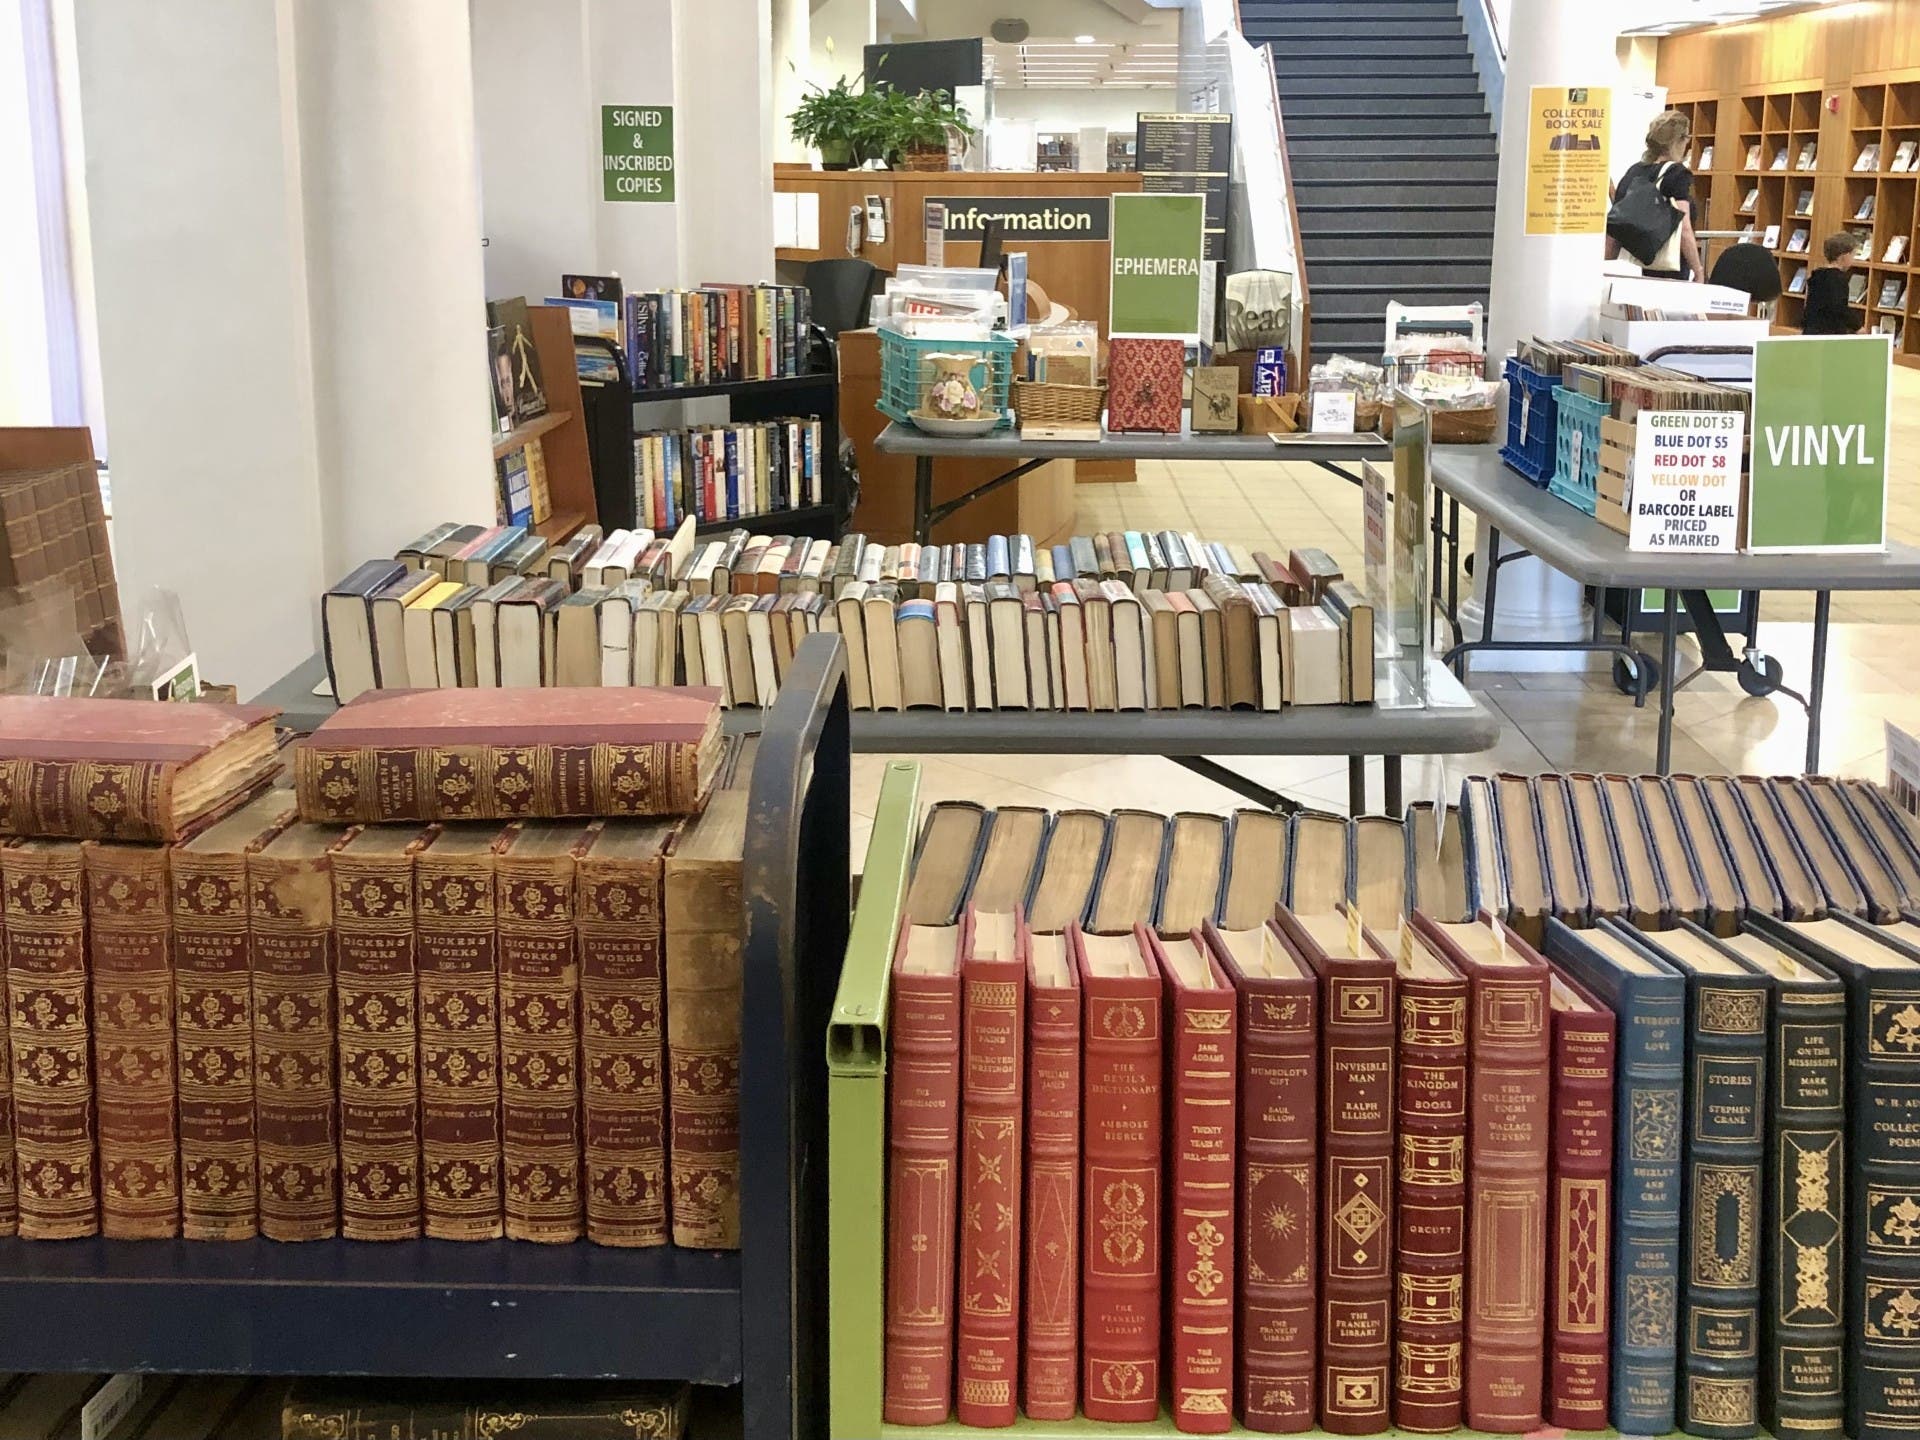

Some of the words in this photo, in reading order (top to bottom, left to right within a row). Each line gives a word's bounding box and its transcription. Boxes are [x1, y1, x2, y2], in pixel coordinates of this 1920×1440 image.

[1542, 108, 1604, 118] COLLECTIBLE
[613, 110, 662, 127] SIGNED
[1546, 119, 1577, 129] BOOK
[1582, 119, 1602, 129] SALE
[633, 133, 643, 149] &
[604, 155, 673, 171] INSCRIBED
[616, 177, 662, 193] COPIES
[944, 208, 1091, 230] Infomation
[1115, 257, 1199, 276] EPHEMERA
[638, 303, 649, 334] Silva
[1650, 415, 1690, 428] GREEN
[1693, 416, 1718, 429] DOT
[1654, 435, 1684, 448] BLUE
[1687, 436, 1712, 448] DOT
[1764, 424, 1875, 466] VINYL
[1654, 454, 1678, 467] RED
[1681, 455, 1706, 468] DOT
[1651, 474, 1699, 486] YELLOW
[1702, 475, 1726, 487] DOT
[1679, 490, 1696, 502] OR
[1638, 503, 1696, 517] BARCODE
[1699, 504, 1734, 518] LABEL
[1664, 519, 1707, 532] PRICED
[1649, 534, 1664, 546] AS
[1668, 534, 1720, 547] MARKED
[380, 756, 391, 815] DICKENS
[12, 934, 74, 945] DICKENS
[180, 936, 242, 946] DICKENS
[257, 938, 320, 948] DICKENS
[343, 938, 406, 947] DICKENS
[424, 936, 486, 946] DICKENS
[504, 940, 566, 950] DICKENS
[588, 942, 652, 951] DICKENS
[19, 946, 66, 958] WORKS
[186, 947, 233, 956] WORKS
[263, 950, 311, 959] WORKS
[350, 950, 397, 958] WORKS
[431, 948, 478, 956] WORKS
[510, 951, 558, 960] WORKS
[596, 954, 644, 962] WORKS
[975, 1026, 1010, 1034] THOMAS
[1804, 1036, 1824, 1045] LIFE
[1198, 1044, 1218, 1052] JANE
[1797, 1047, 1812, 1056] ON
[1814, 1047, 1830, 1056] THE
[1192, 1052, 1225, 1062] ADDAMS
[1336, 1062, 1388, 1072] INVISIBLE
[1788, 1058, 1838, 1067] MISSISSIPPI
[1112, 1064, 1136, 1072] THE
[1250, 1066, 1308, 1076] HUMBOLDT'S
[1103, 1074, 1146, 1084] DEVIL'S
[1348, 1072, 1376, 1083] MAN
[1424, 1071, 1446, 1080] THE
[1708, 1075, 1752, 1085] STORIES
[1270, 1078, 1290, 1086] GIFT
[1407, 1080, 1458, 1090] KINGDOM
[1800, 1076, 1828, 1086] MARK
[1092, 1084, 1157, 1094] DICTIONARY
[1502, 1085, 1522, 1093] THE
[1798, 1088, 1829, 1098] TWAIN
[1482, 1094, 1538, 1103] COLLECTED
[1346, 1102, 1378, 1112] RALPH
[1415, 1100, 1452, 1110] BOOKS
[1494, 1104, 1527, 1113] POEMS
[1708, 1105, 1750, 1114] STEPHEN
[1268, 1106, 1290, 1115] SAUL
[1342, 1110, 1381, 1120] ELLISON
[1263, 1114, 1296, 1123] BELLOW
[1714, 1114, 1747, 1124] CRANE
[1100, 1120, 1149, 1129] AMBROSE
[1488, 1123, 1532, 1132] WALLACE
[1192, 1126, 1222, 1135] TWENTY
[1105, 1131, 1144, 1141] BIERCE
[1488, 1132, 1532, 1142] STEVENS
[1633, 1168, 1674, 1177] SHIRLEY
[1410, 1225, 1452, 1234] ORCUTT
[1116, 1304, 1132, 1312] THE
[1102, 1315, 1146, 1324] FRANKLIN
[1350, 1312, 1368, 1320] THE
[1272, 1320, 1287, 1328] THE
[1336, 1320, 1381, 1329] FRANKLIN
[1260, 1328, 1298, 1336] FRANKLIN
[1340, 1328, 1377, 1337] LIBRARY
[1198, 1349, 1212, 1357] THE
[1187, 1357, 1222, 1366] FRANKLIN
[1804, 1356, 1822, 1364] THE
[1188, 1366, 1221, 1374] LIBRARY
[1792, 1365, 1833, 1374] FRANKLIN
[1794, 1375, 1830, 1384] LIBRARY
